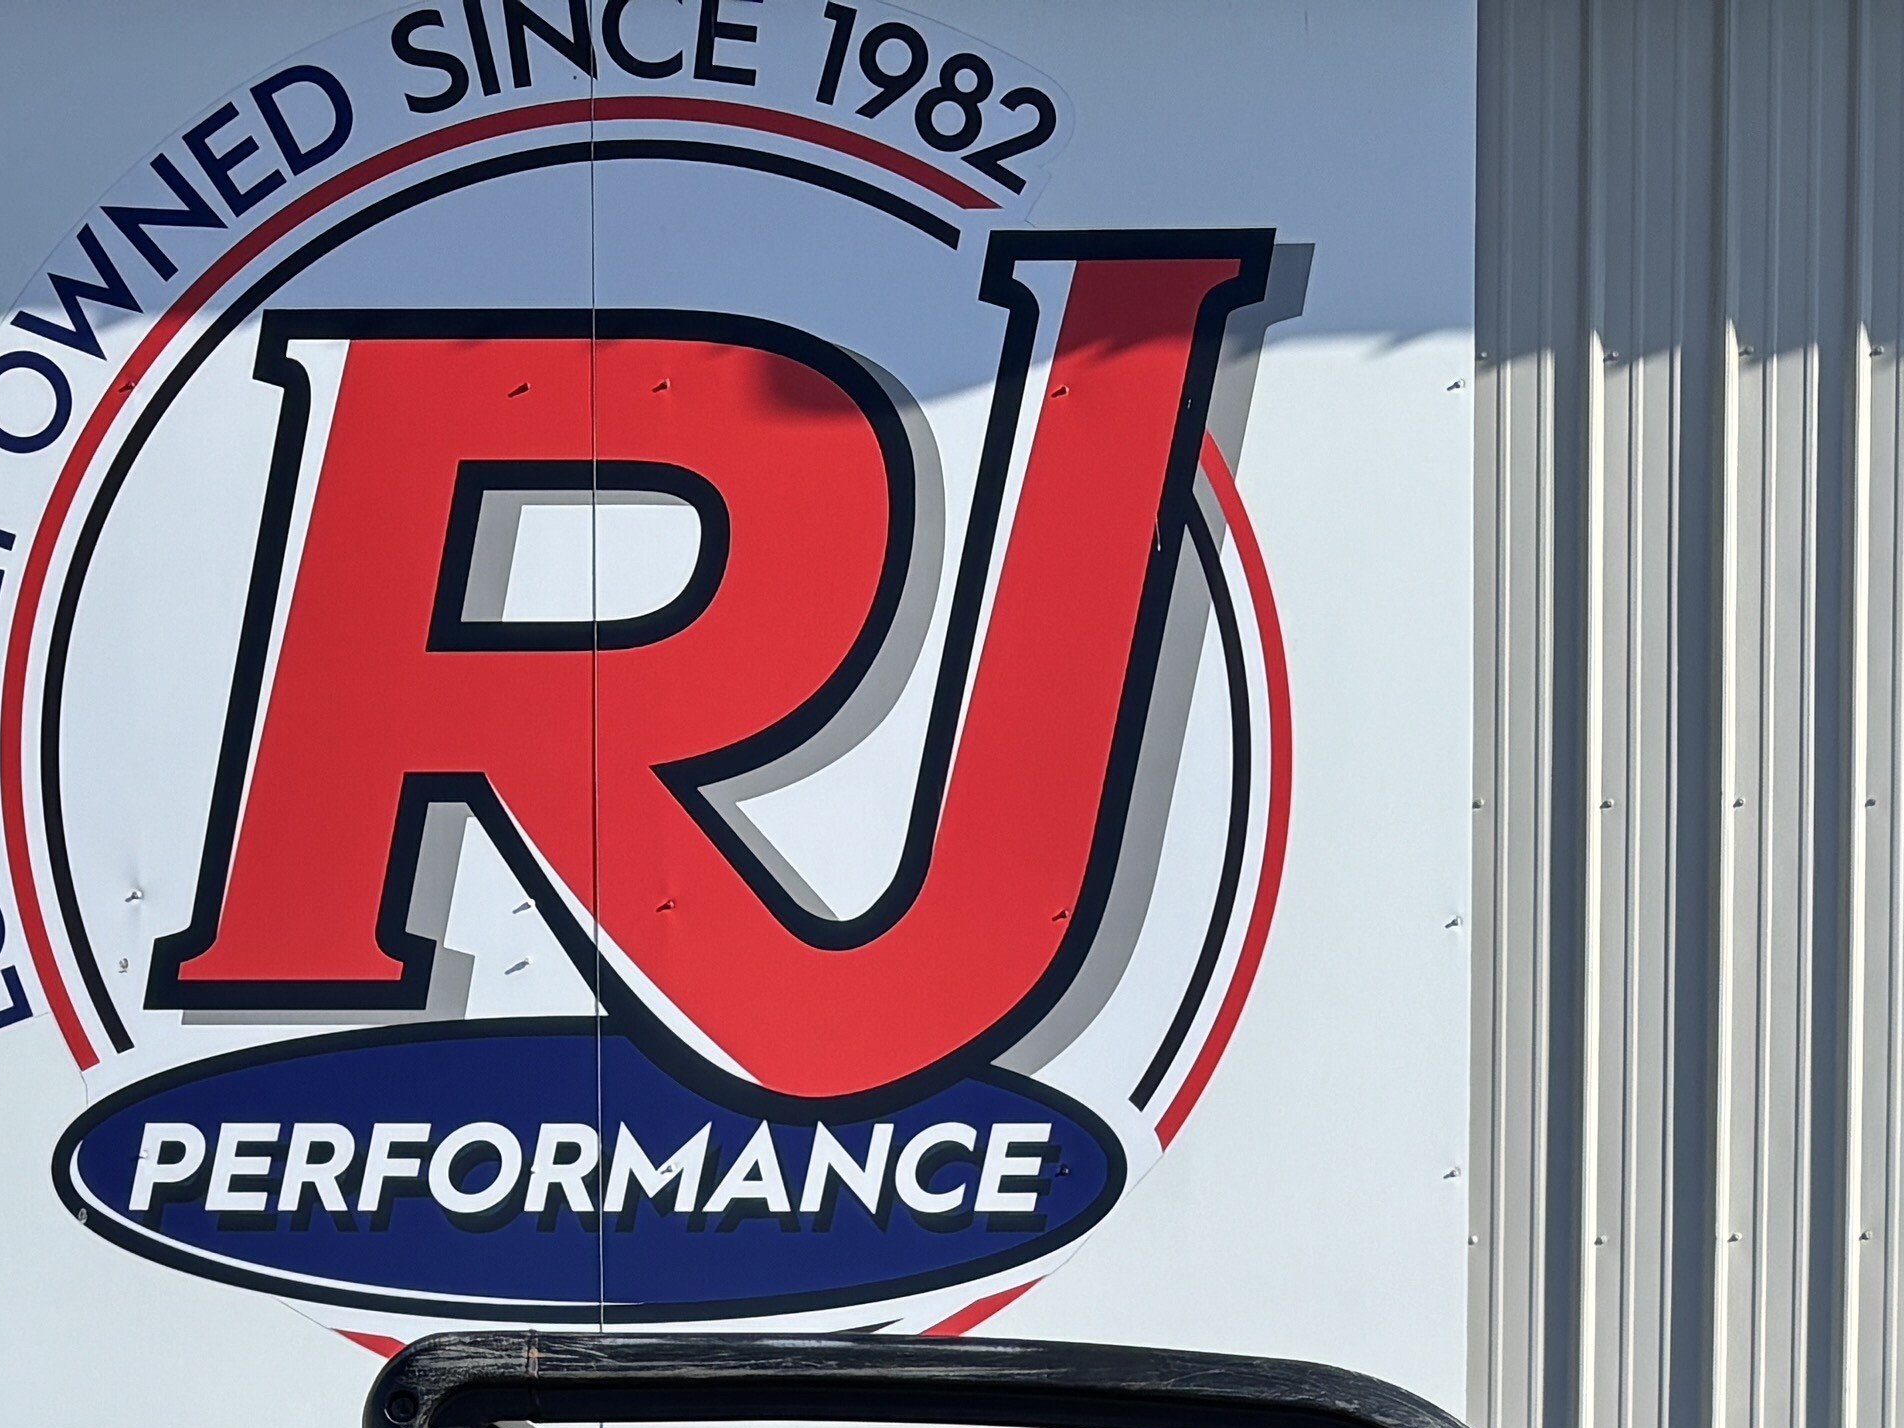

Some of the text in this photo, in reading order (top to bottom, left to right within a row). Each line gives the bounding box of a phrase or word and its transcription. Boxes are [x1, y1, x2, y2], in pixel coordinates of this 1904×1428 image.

[391, 0, 763, 113] SINCE
[815, 0, 1057, 195] 1982
[143, 229, 1274, 1121] RJ
[127, 1121, 1052, 1215] PERFORMANCE
